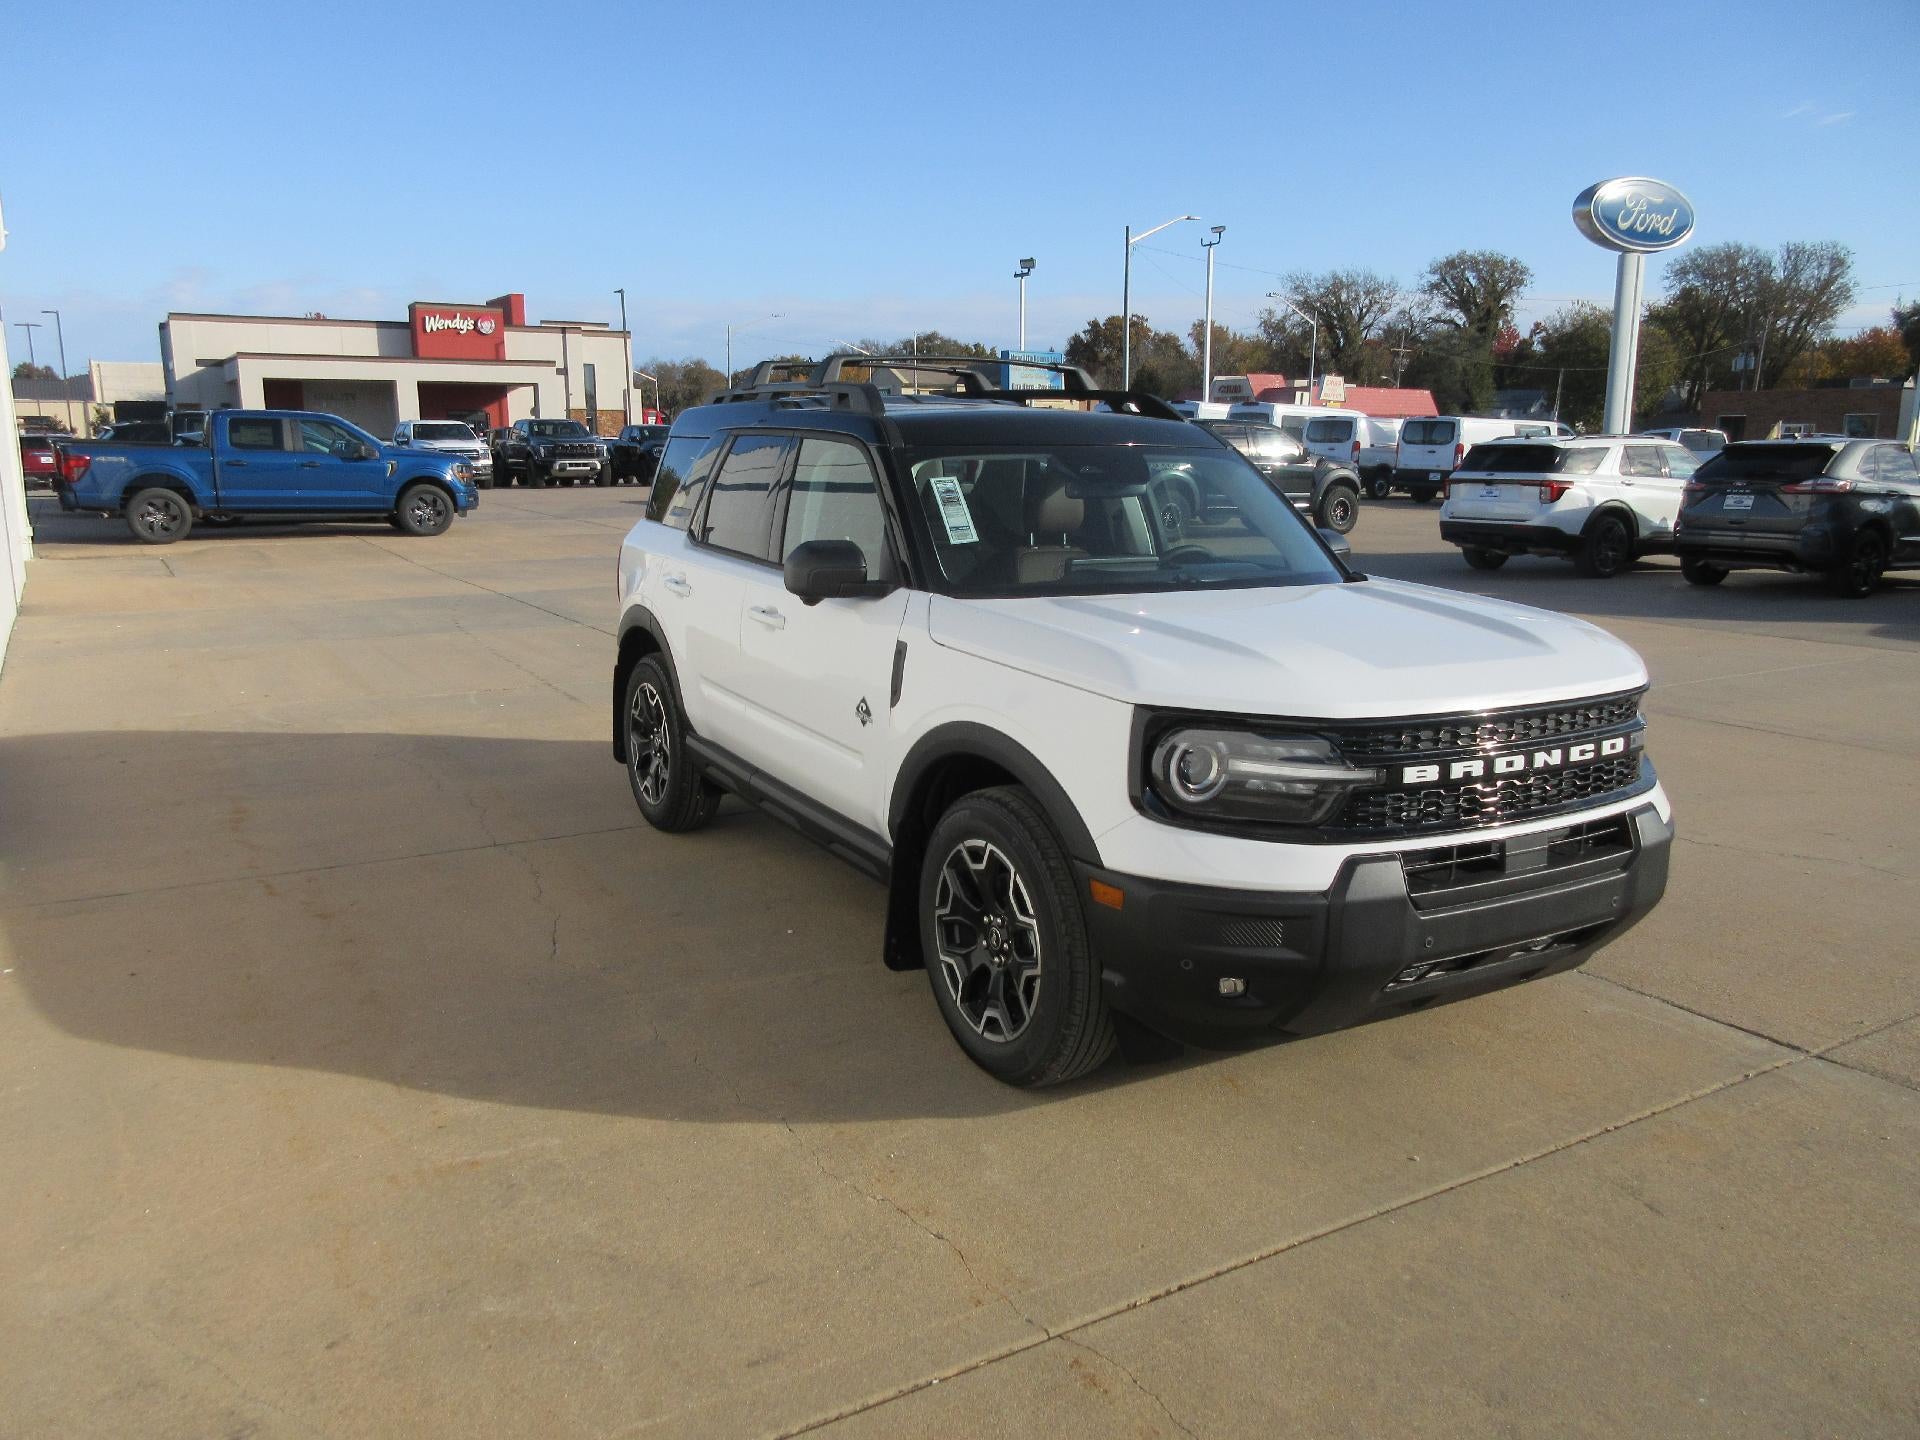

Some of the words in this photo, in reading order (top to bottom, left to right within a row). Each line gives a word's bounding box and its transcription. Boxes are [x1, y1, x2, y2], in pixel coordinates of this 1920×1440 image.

[1617, 191, 1678, 236] Ford
[425, 313, 475, 335] Wendy's
[1402, 737, 1625, 785] BRONCO
